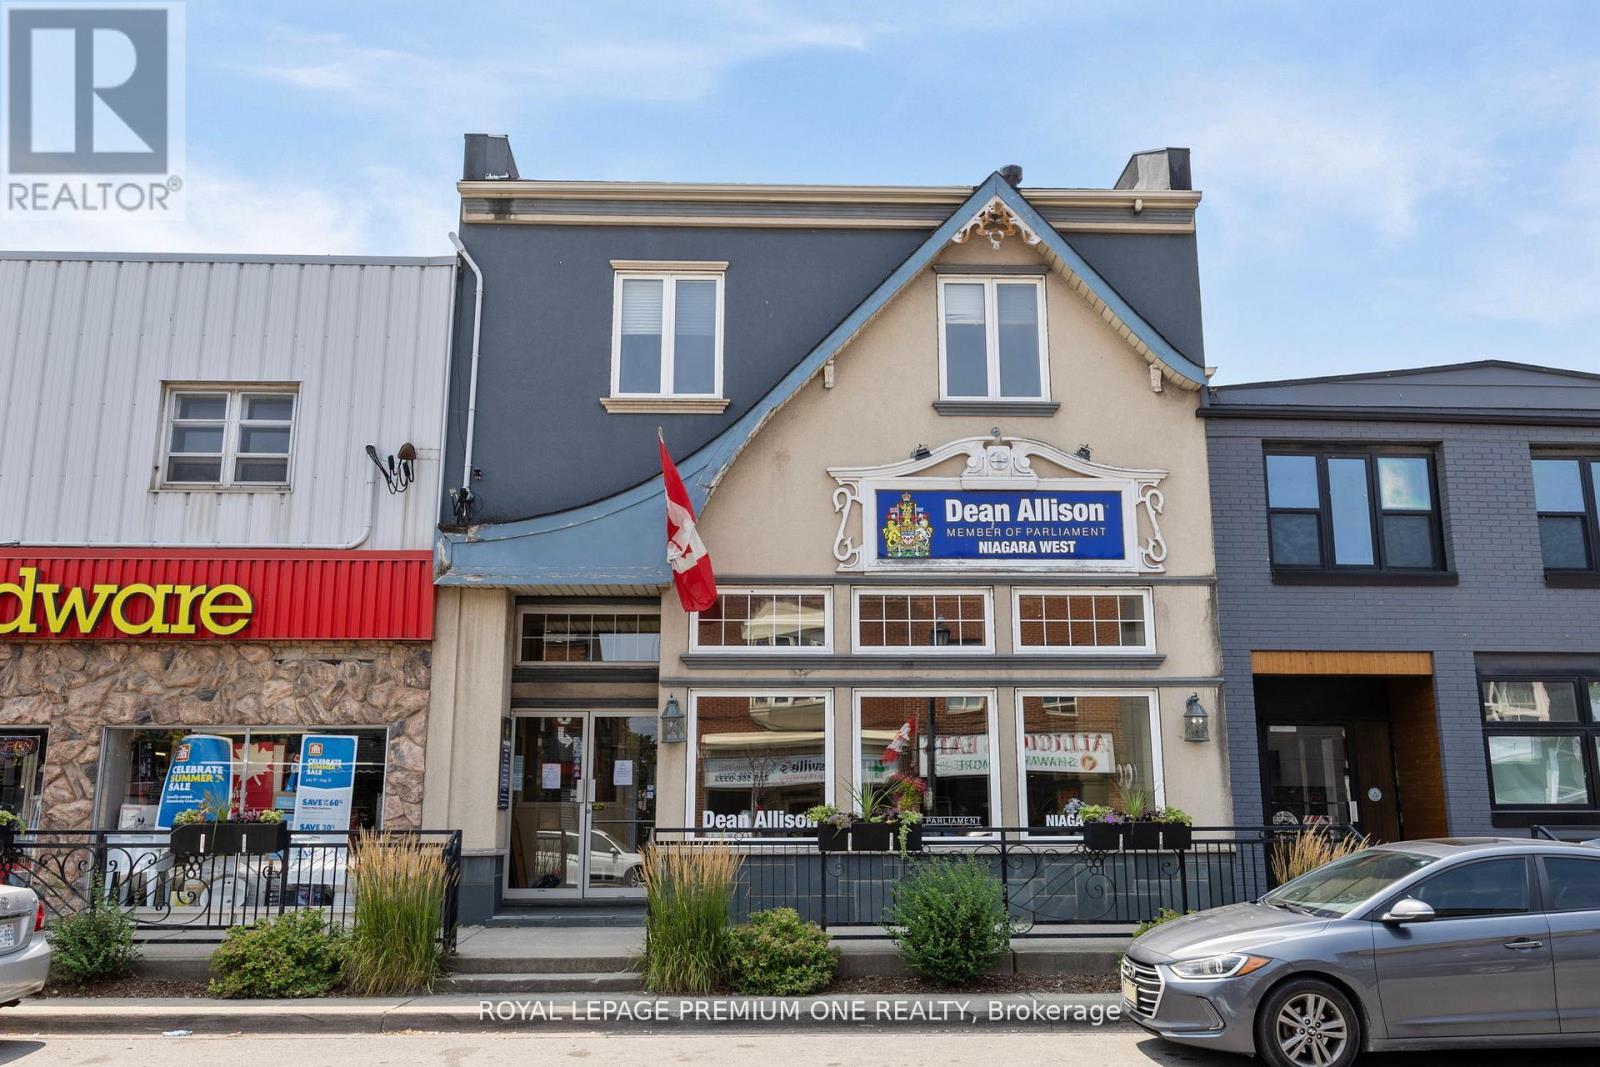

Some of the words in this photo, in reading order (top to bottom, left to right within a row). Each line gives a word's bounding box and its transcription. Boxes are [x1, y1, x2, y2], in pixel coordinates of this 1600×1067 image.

[945, 499, 1010, 522] Dean
[1017, 498, 1104, 522] Allison
[947, 528, 1001, 537] MEMBER
[1005, 528, 1021, 536] OF
[1026, 527, 1106, 536] PARLIAMENT
[979, 541, 1038, 553] NIAGARA
[1039, 541, 1076, 553] WEST
[0, 567, 253, 635] dware
[172, 765, 224, 774] CELEBRATE
[170, 774, 213, 783] SUMMER
[168, 782, 191, 791] SALE
[703, 810, 752, 828] Dean
[926, 817, 981, 825] PARLIAMENT
[300, 823, 320, 831] SAVE
